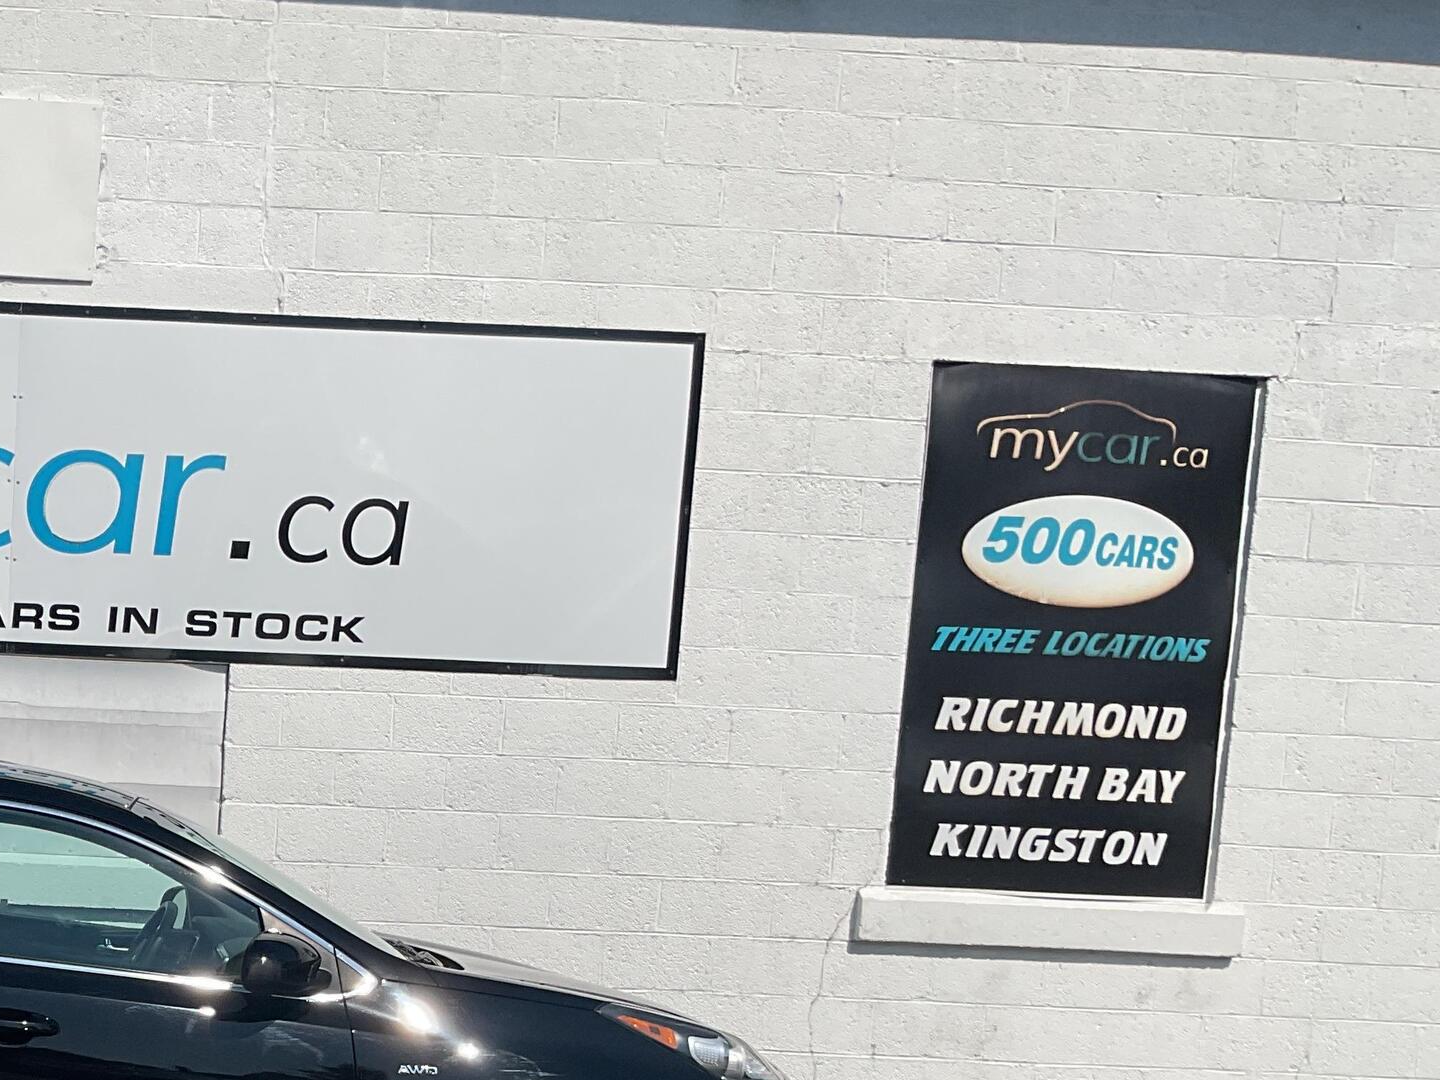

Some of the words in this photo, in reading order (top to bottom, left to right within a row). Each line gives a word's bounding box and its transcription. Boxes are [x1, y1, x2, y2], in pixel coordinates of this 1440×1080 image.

[988, 425, 1210, 471] mycar.ca
[982, 516, 1096, 566] 500
[1095, 531, 1179, 570] CARS
[107, 606, 159, 634] IN
[184, 611, 366, 644] STOCK
[931, 626, 1035, 655] THREE
[1044, 631, 1211, 663] LOCATIONS
[934, 696, 1188, 741] RICHMOND
[923, 759, 1090, 800] NORTH
[1097, 766, 1186, 804] BAY
[930, 823, 1168, 867] KINGSTON
